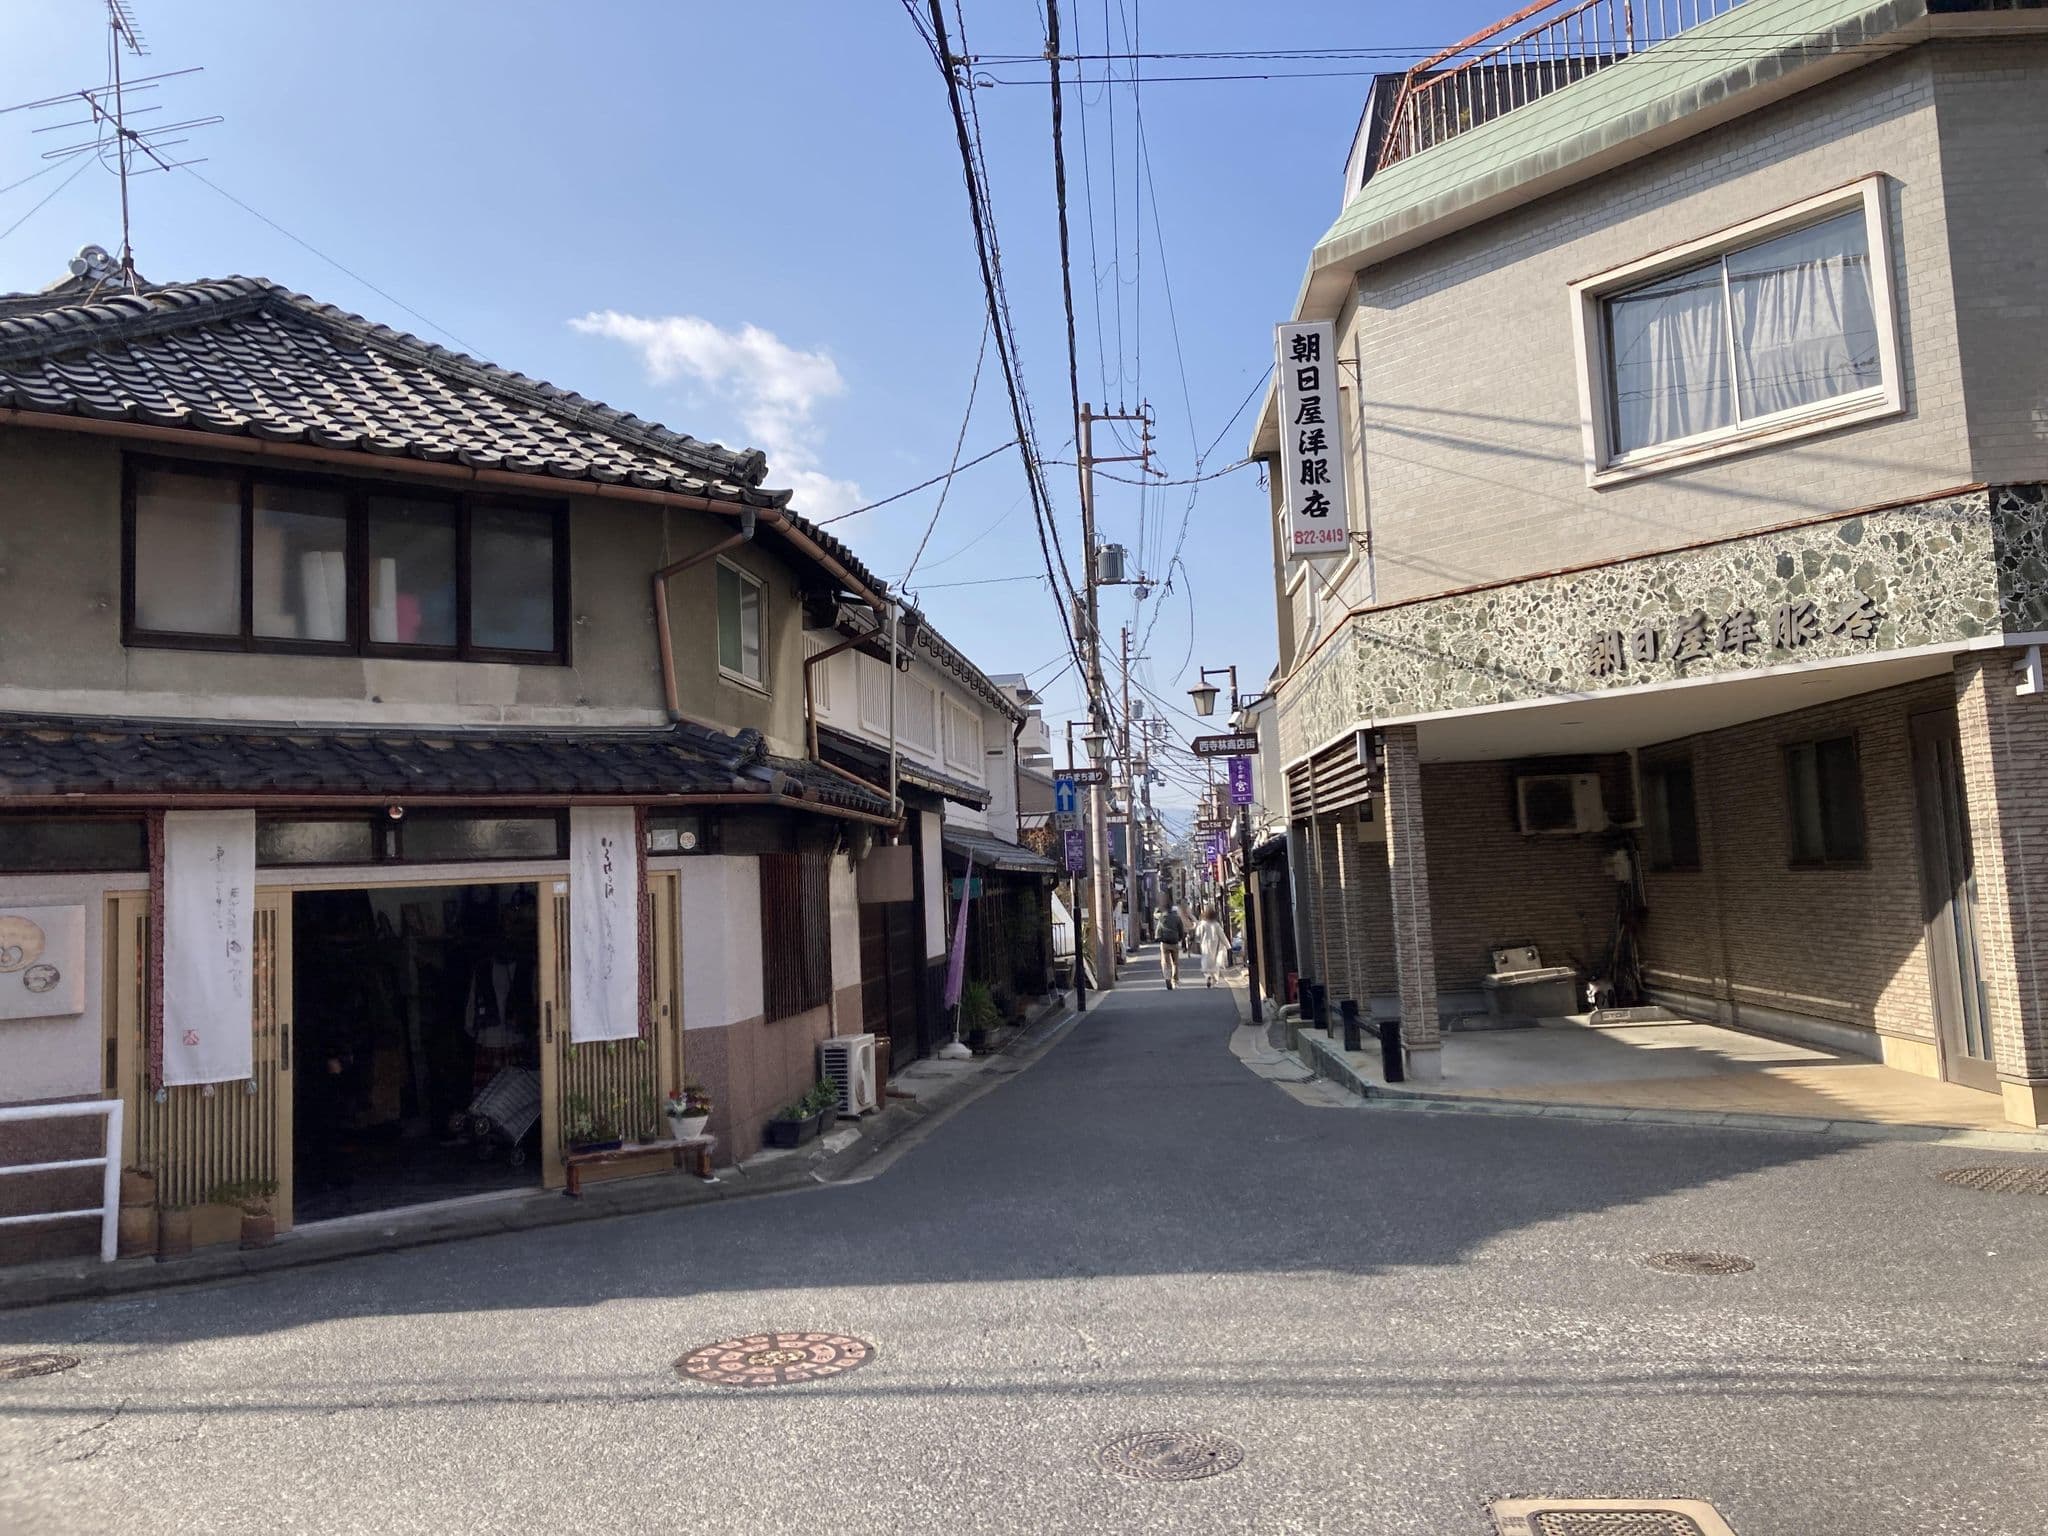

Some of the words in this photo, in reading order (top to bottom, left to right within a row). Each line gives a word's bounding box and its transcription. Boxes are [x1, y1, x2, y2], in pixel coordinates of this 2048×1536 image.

[1289, 333, 1331, 519] 朝日屋洋服店
